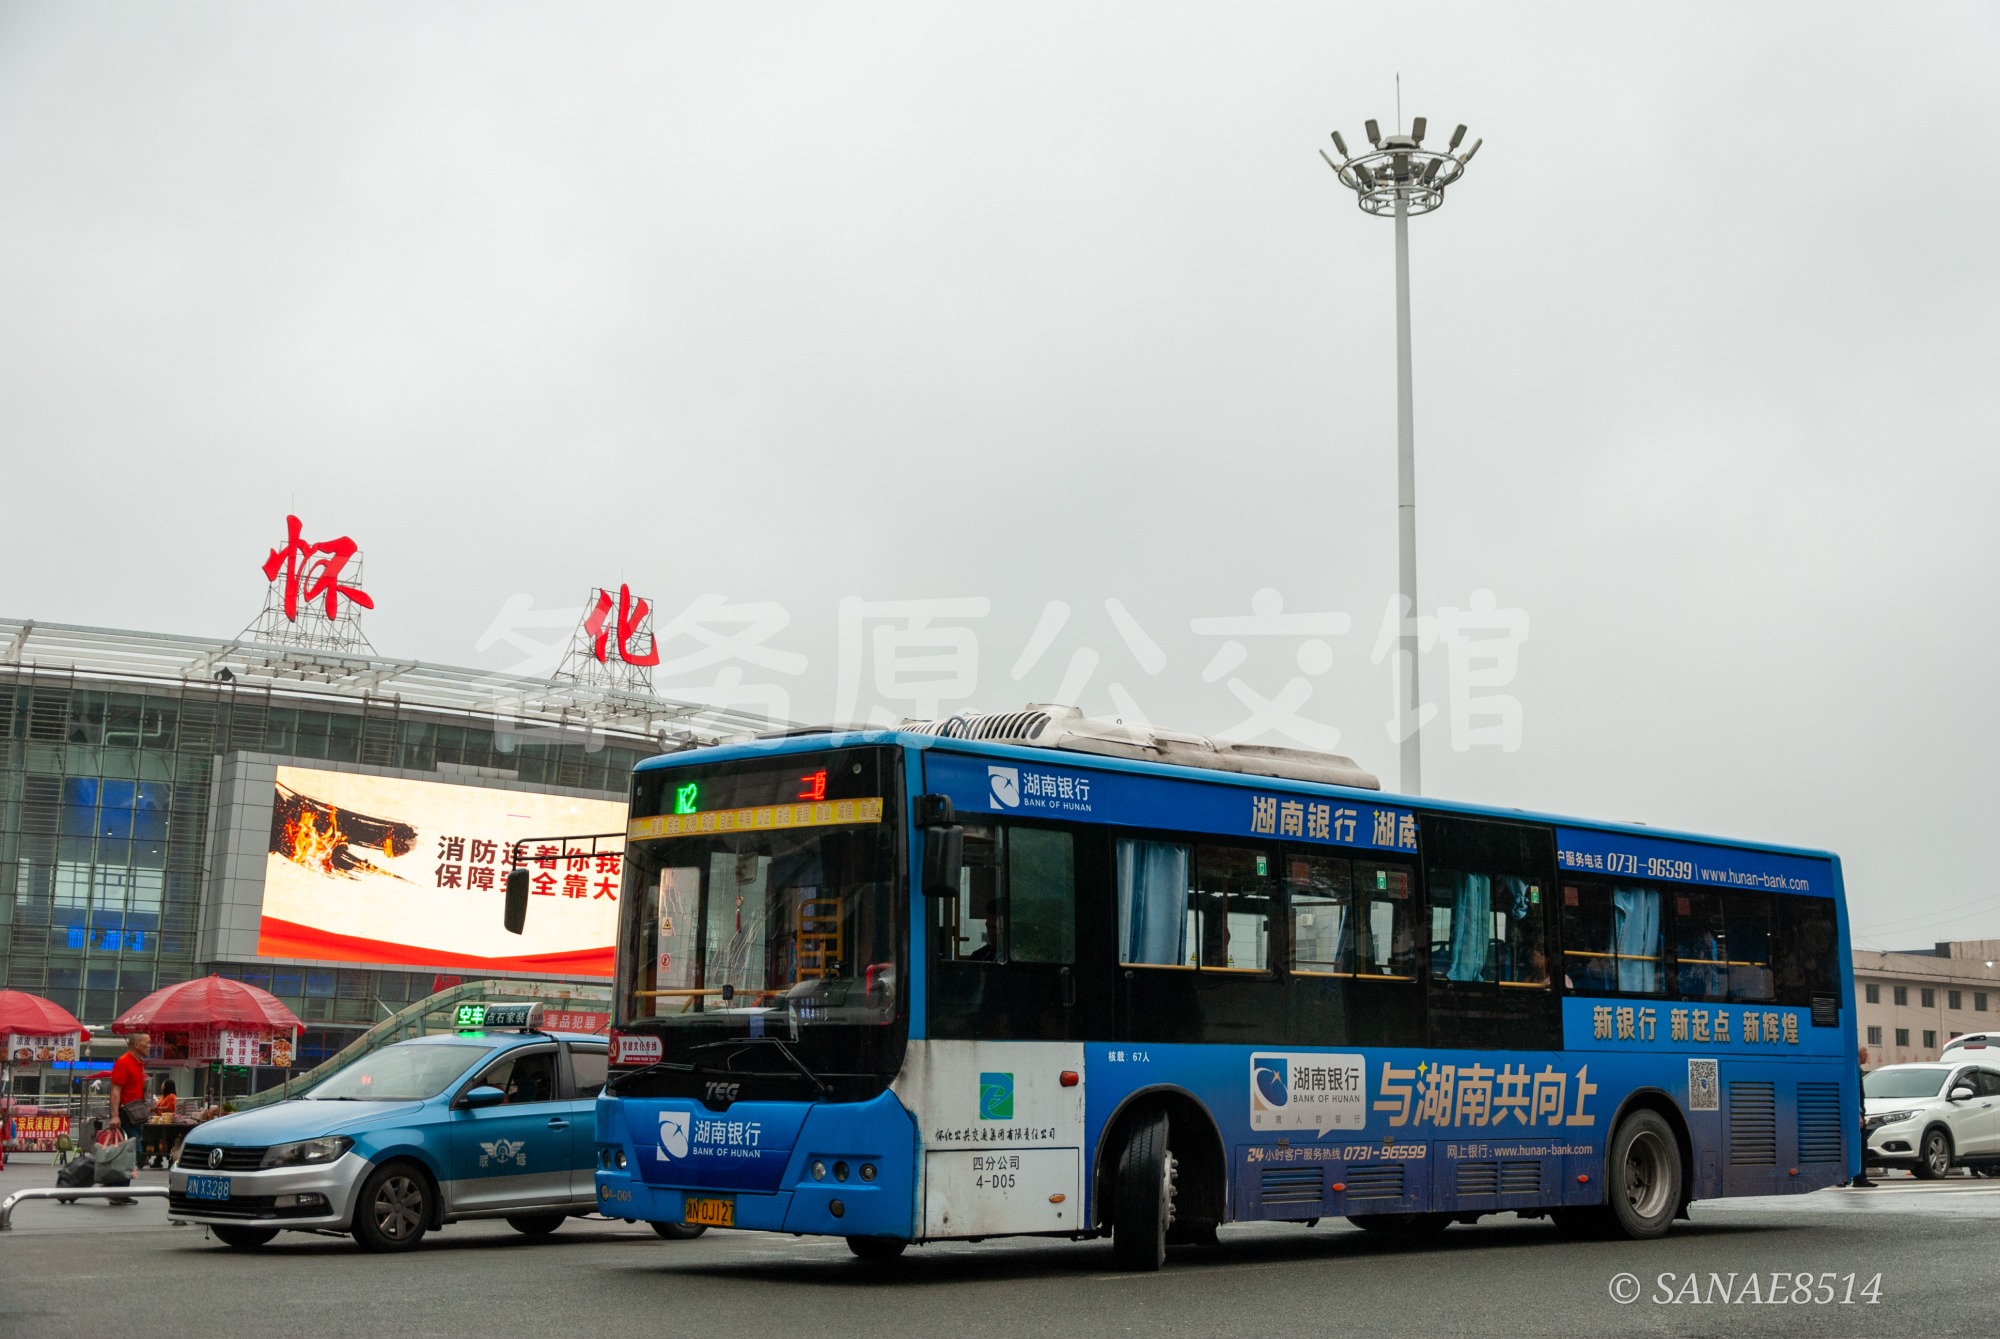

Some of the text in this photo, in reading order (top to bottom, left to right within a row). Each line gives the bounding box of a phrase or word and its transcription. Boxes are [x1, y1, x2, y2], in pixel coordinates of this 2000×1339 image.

[262, 514, 660, 667] 怀 化
[1023, 772, 1091, 801] 湖南银行
[1024, 798, 1092, 812] BANK OF HUNAN
[1251, 795, 1417, 849] 湖南银行 湖南
[437, 835, 622, 876] 消防连着你我
[1607, 852, 1693, 880] 0731-96599
[1701, 867, 1810, 892] www.hunan-bank.com
[458, 1006, 484, 1024] 空车
[486, 1011, 526, 1025] 点石家装
[543, 1014, 596, 1029] 毒品犯罪
[1593, 1005, 1799, 1045] 新银行 新起点 新辉煌
[622, 1040, 657, 1051] 党建文化专线
[1293, 1066, 1360, 1091] 湖南银行
[705, 1081, 740, 1101] TEG
[1293, 1095, 1360, 1103] BANK OF HUNAN
[1373, 1061, 1598, 1127] 与湖南共向上
[693, 1120, 761, 1147] 湖南银行
[692, 1147, 761, 1158] BANK OF HUNAN
[1343, 1145, 1427, 1161] 0731-96599
[973, 1155, 1020, 1171] 四分公司
[976, 1174, 1015, 1188] 4-D05
